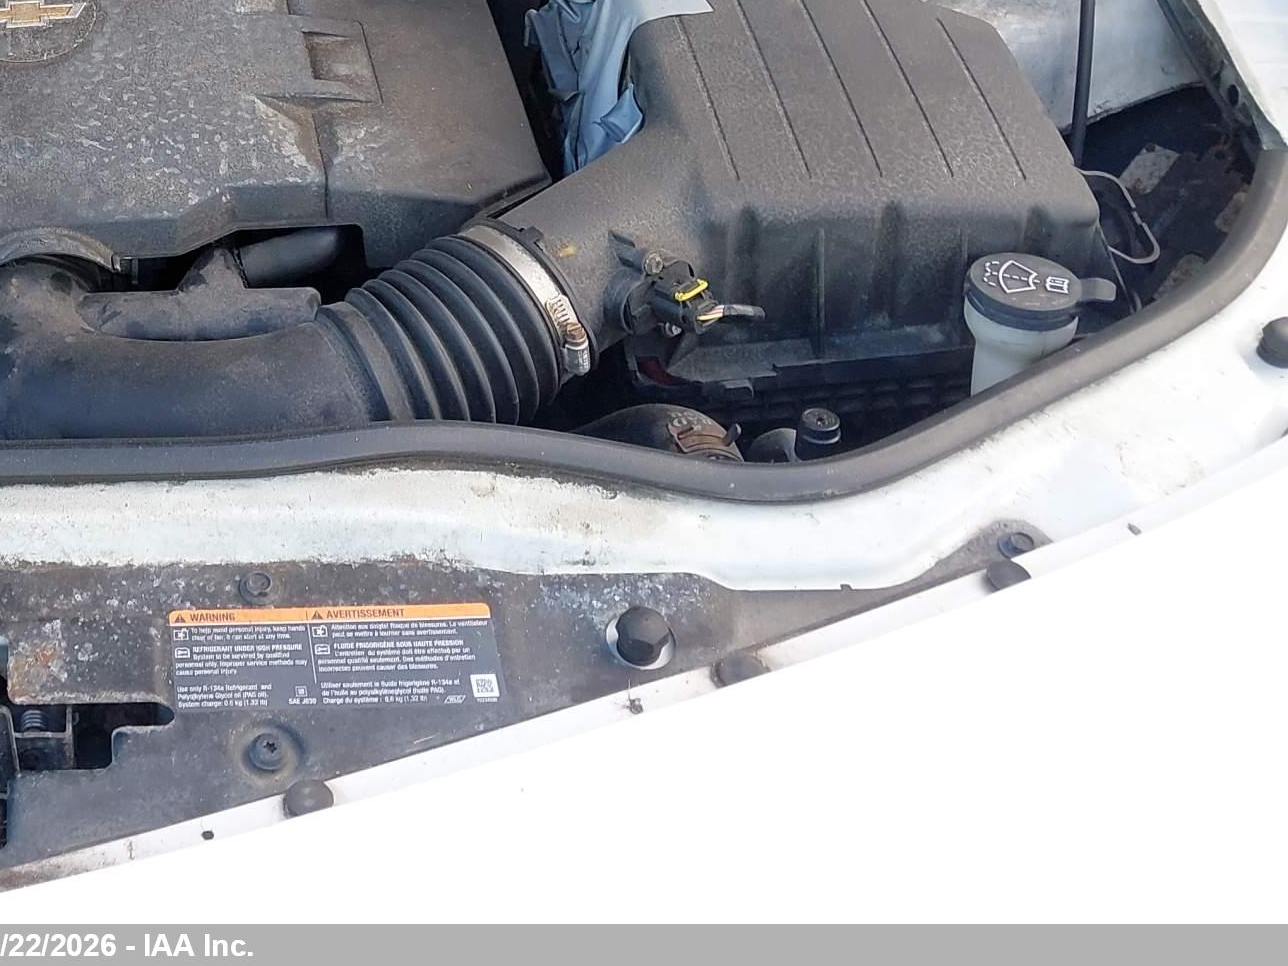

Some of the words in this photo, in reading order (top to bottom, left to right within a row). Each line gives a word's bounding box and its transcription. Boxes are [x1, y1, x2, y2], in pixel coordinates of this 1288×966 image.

[190, 613, 235, 622] WARNING
[327, 609, 404, 619] AVERTISSEMENT
[199, 627, 212, 635] help
[229, 626, 254, 634] personal
[192, 645, 233, 653] REFRIGERANT
